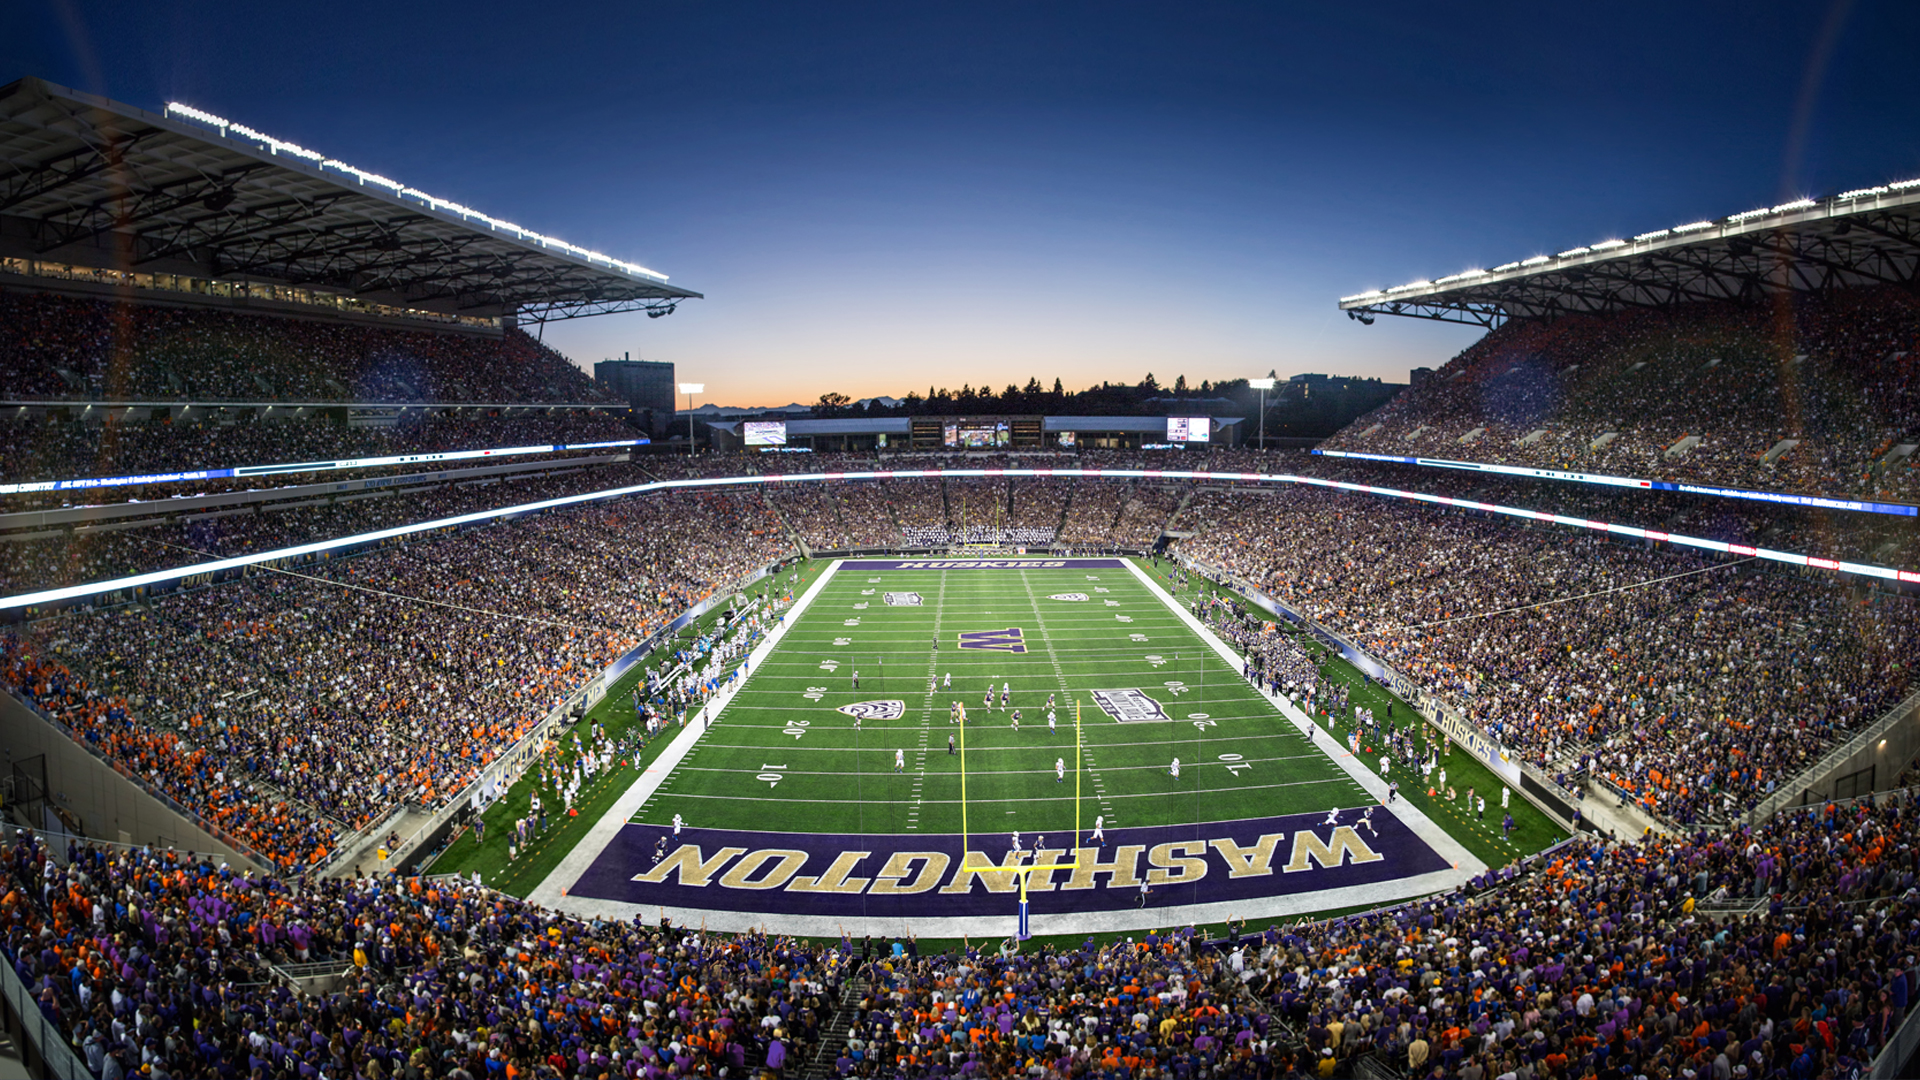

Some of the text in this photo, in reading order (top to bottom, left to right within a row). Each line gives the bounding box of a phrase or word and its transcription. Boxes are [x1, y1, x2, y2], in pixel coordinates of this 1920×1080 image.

[895, 560, 1067, 569] HUSKIES
[957, 627, 1029, 654] W
[802, 686, 827, 699] 30
[1164, 681, 1189, 693] 30
[782, 719, 811, 735] 20
[1188, 713, 1217, 728] 20
[1441, 712, 1493, 762] HUSKIES
[1218, 753, 1252, 771] 10
[756, 764, 788, 782] 10
[631, 824, 1385, 896] WASHINGTON
